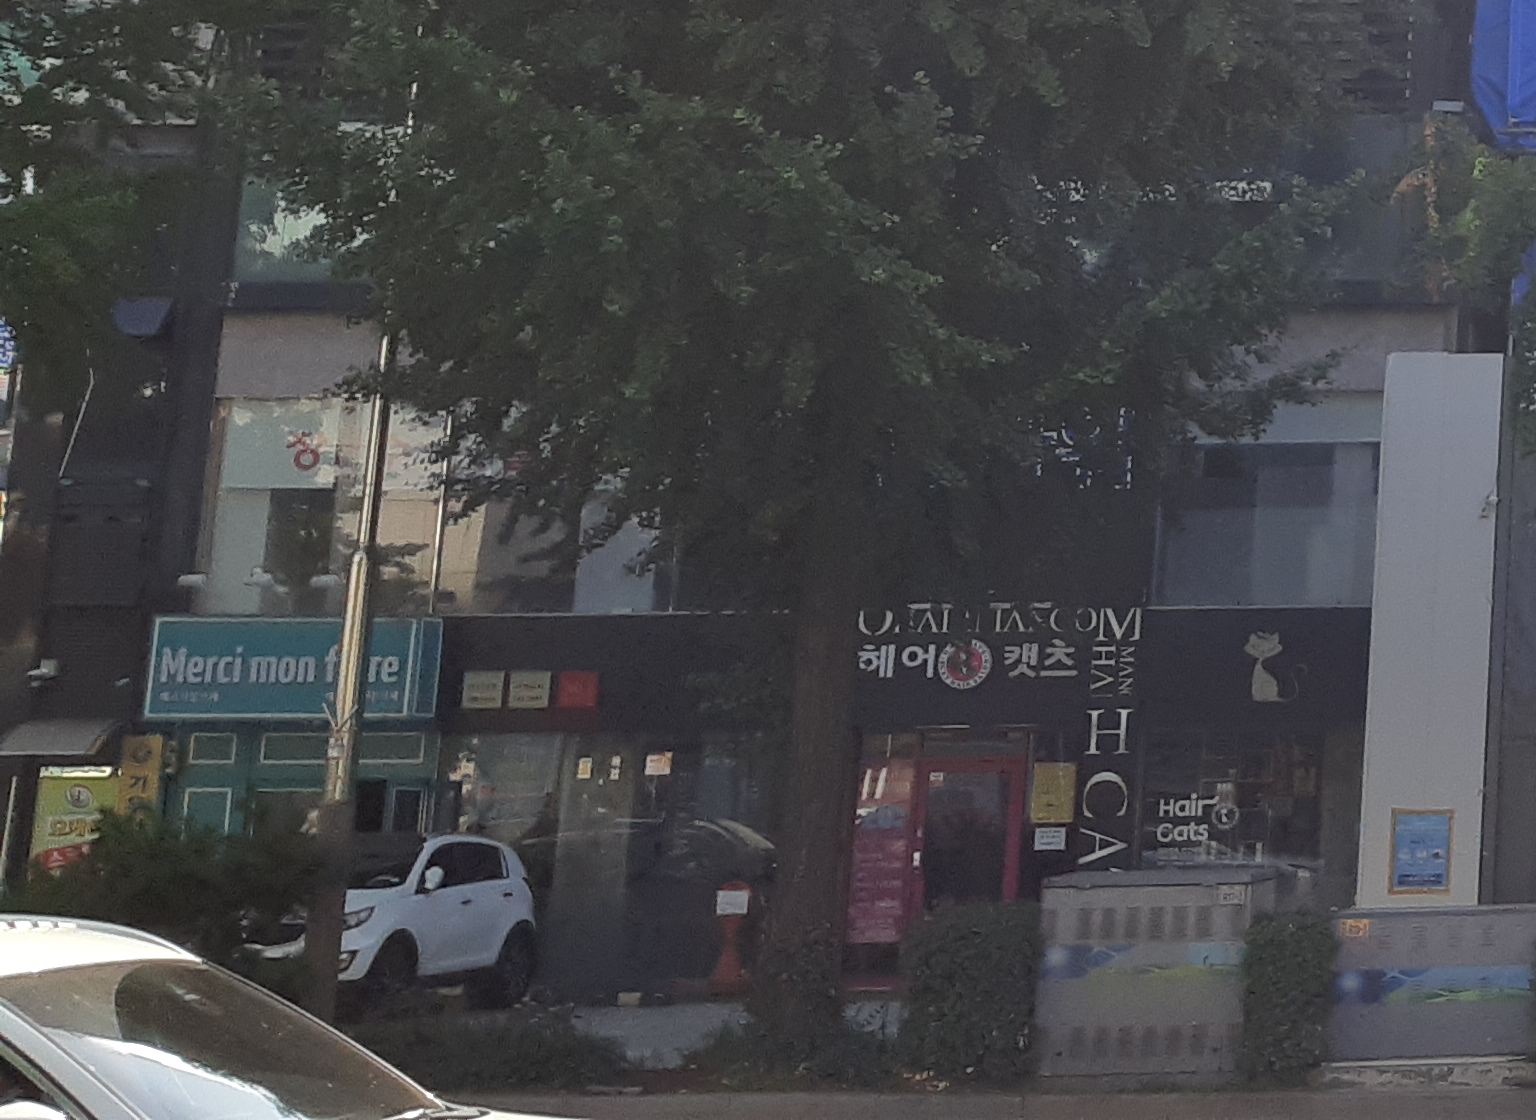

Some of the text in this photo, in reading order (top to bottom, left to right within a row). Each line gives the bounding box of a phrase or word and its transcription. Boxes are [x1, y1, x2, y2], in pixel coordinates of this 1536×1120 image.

[159, 646, 243, 684] Merci
[250, 655, 317, 683] mon
[858, 644, 936, 678] 헤어
[1004, 639, 1078, 678] 캣츠
[1158, 792, 1220, 818] Hair
[1156, 821, 1209, 842] Cats
